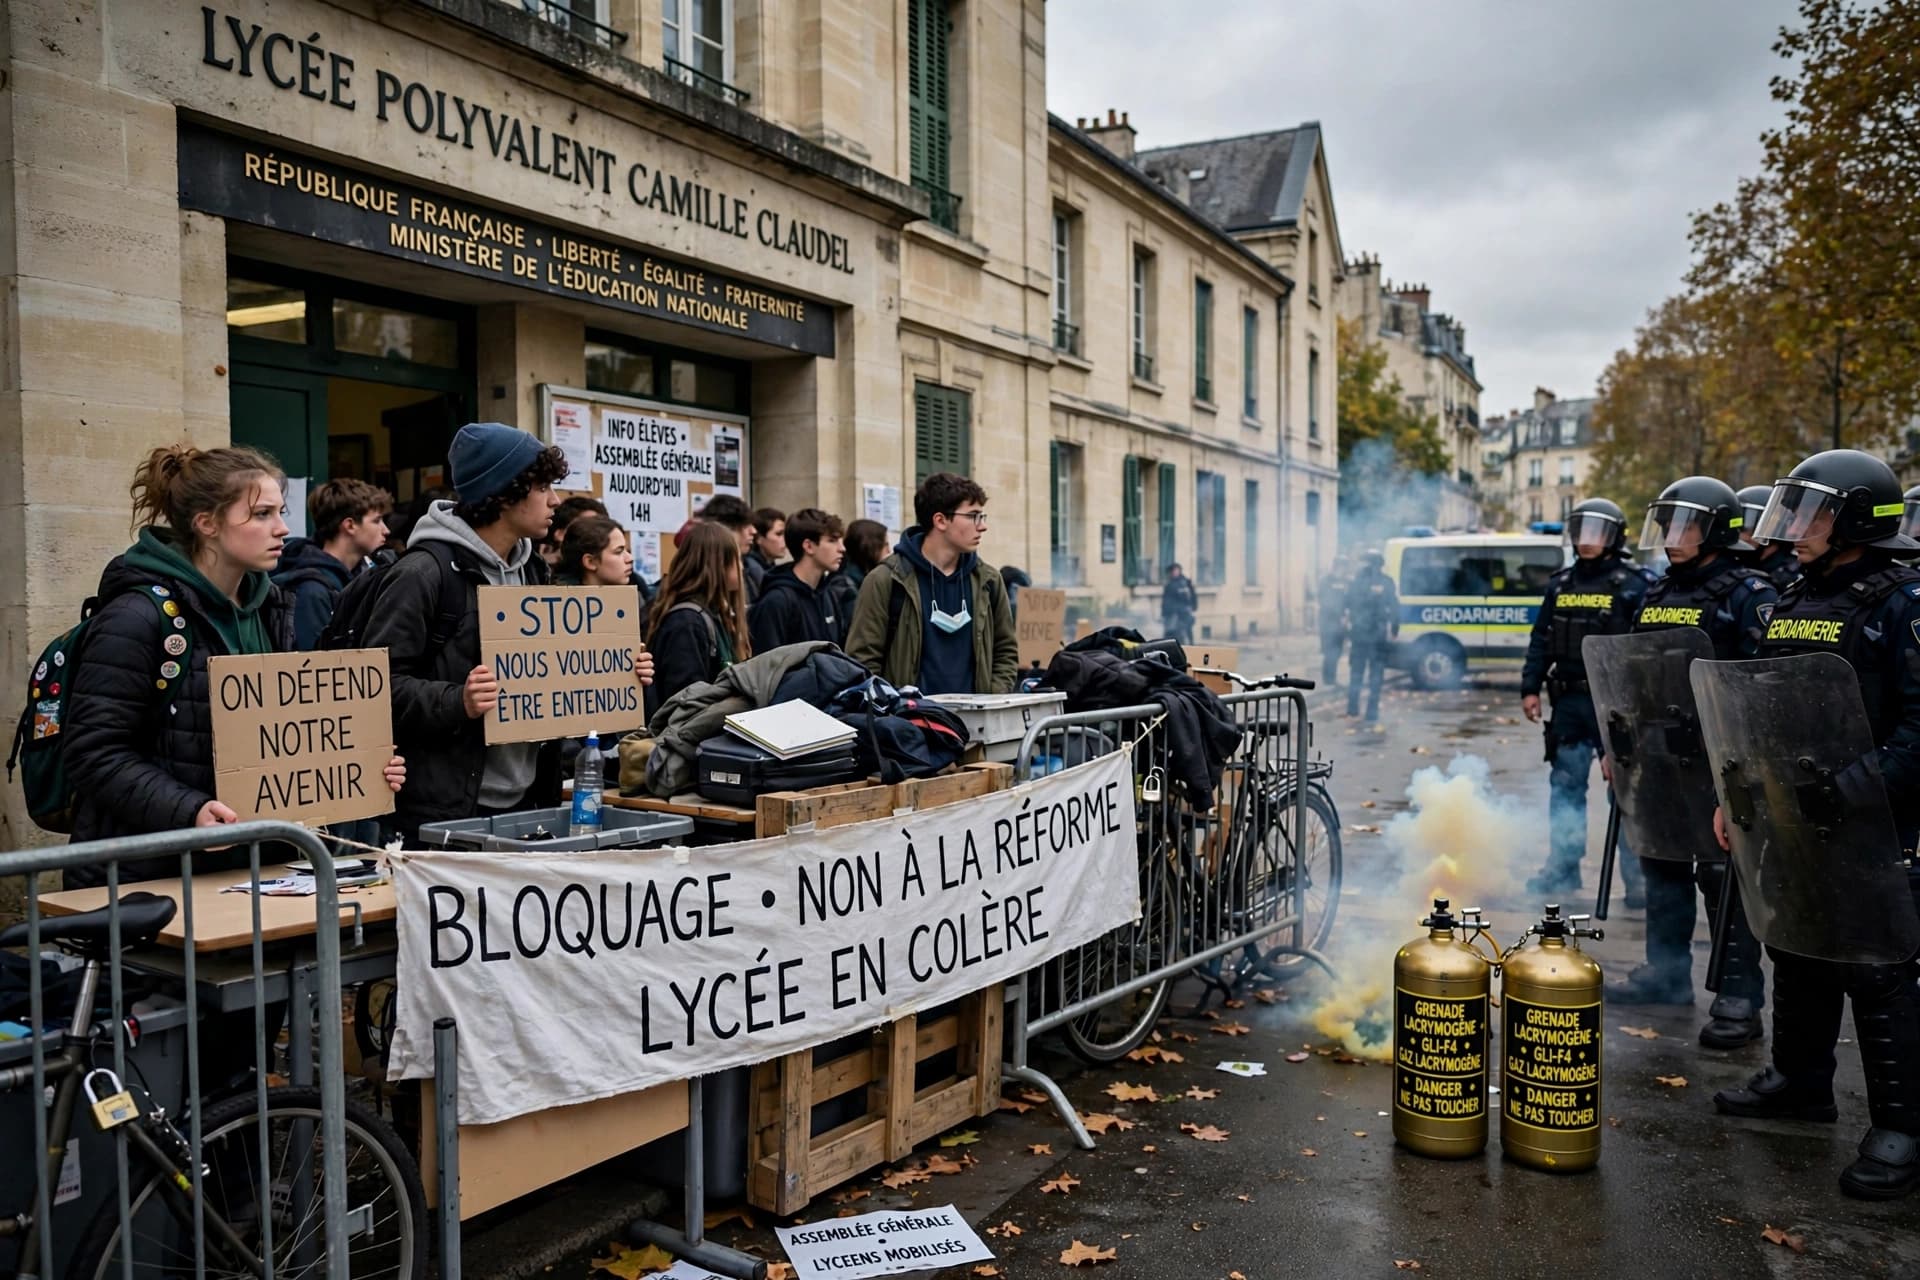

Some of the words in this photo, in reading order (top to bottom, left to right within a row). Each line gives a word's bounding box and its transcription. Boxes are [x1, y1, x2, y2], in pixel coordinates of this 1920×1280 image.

[201, 6, 356, 111] LYCÉE
[376, 69, 617, 195] POLYVALENT
[628, 163, 748, 239] CAMILLE
[757, 209, 855, 275] CLAUDEL
[245, 152, 399, 216] RÉPUBLIQUE
[410, 197, 525, 249] FRANÇAISE
[552, 236, 621, 275] LIBERTÉ
[643, 257, 706, 296] ÉGALITÉ
[725, 284, 805, 323] FRATERNITÉ
[390, 223, 503, 271] MINISTÈRE
[513, 254, 537, 280] DE
[548, 257, 659, 308] L'ÉDUCATION
[667, 289, 748, 330] NATIONALE
[608, 418, 635, 440] INFO
[639, 417, 677, 445] ÉLÈVES
[594, 444, 657, 470] ASSEMBLÉE
[661, 449, 712, 475] GÉNÉRALE
[609, 473, 681, 498] AUJOURD'HUI
[630, 502, 650, 522] 14H
[520, 596, 603, 636] STOP
[1421, 607, 1529, 623] GENDARMERIE
[1640, 606, 1702, 626] GENDARMERIE
[1767, 619, 1844, 642] GENDARMERIE
[495, 651, 548, 681] NOUS
[556, 648, 633, 676] VOULONS
[220, 672, 263, 711] ON
[278, 658, 383, 706] DÉFEND
[498, 687, 544, 723] ÊTRE
[552, 686, 637, 718] ENTENDUS
[259, 715, 355, 759] NOTRE
[255, 763, 365, 813] AVENIR
[428, 873, 734, 969] BLOQUAGE
[799, 851, 882, 926] NON
[901, 828, 925, 901] À
[939, 828, 983, 891] LA
[994, 781, 1121, 875] RÉFORME
[641, 948, 806, 1054] LYCÉE
[831, 937, 887, 1010] EN
[908, 885, 1049, 982] COLÈRE
[1415, 1000, 1465, 1019] GRENADE
[1526, 1008, 1580, 1028] GRENADE
[1399, 1046, 1414, 1064] GAZ
[1421, 1037, 1458, 1054] GLI-F4
[1534, 1046, 1572, 1064] GLI-F4
[1508, 1055, 1525, 1074] GAZ
[1400, 1088, 1411, 1107] NE
[1413, 1094, 1432, 1112] PAS
[1434, 1097, 1479, 1114] TOUCHER
[1415, 1077, 1463, 1097] DANGER
[1527, 1087, 1577, 1107] DANGER
[1510, 1098, 1522, 1117] NE
[1524, 1105, 1545, 1123] PAS
[1547, 1108, 1594, 1126] TOUCHER
[790, 1222, 876, 1246] ASSEMBLÉE
[878, 1214, 954, 1233] GÉNÉRALE
[813, 1250, 882, 1272] LYCEENS
[884, 1239, 967, 1262] MOBILISÉS
